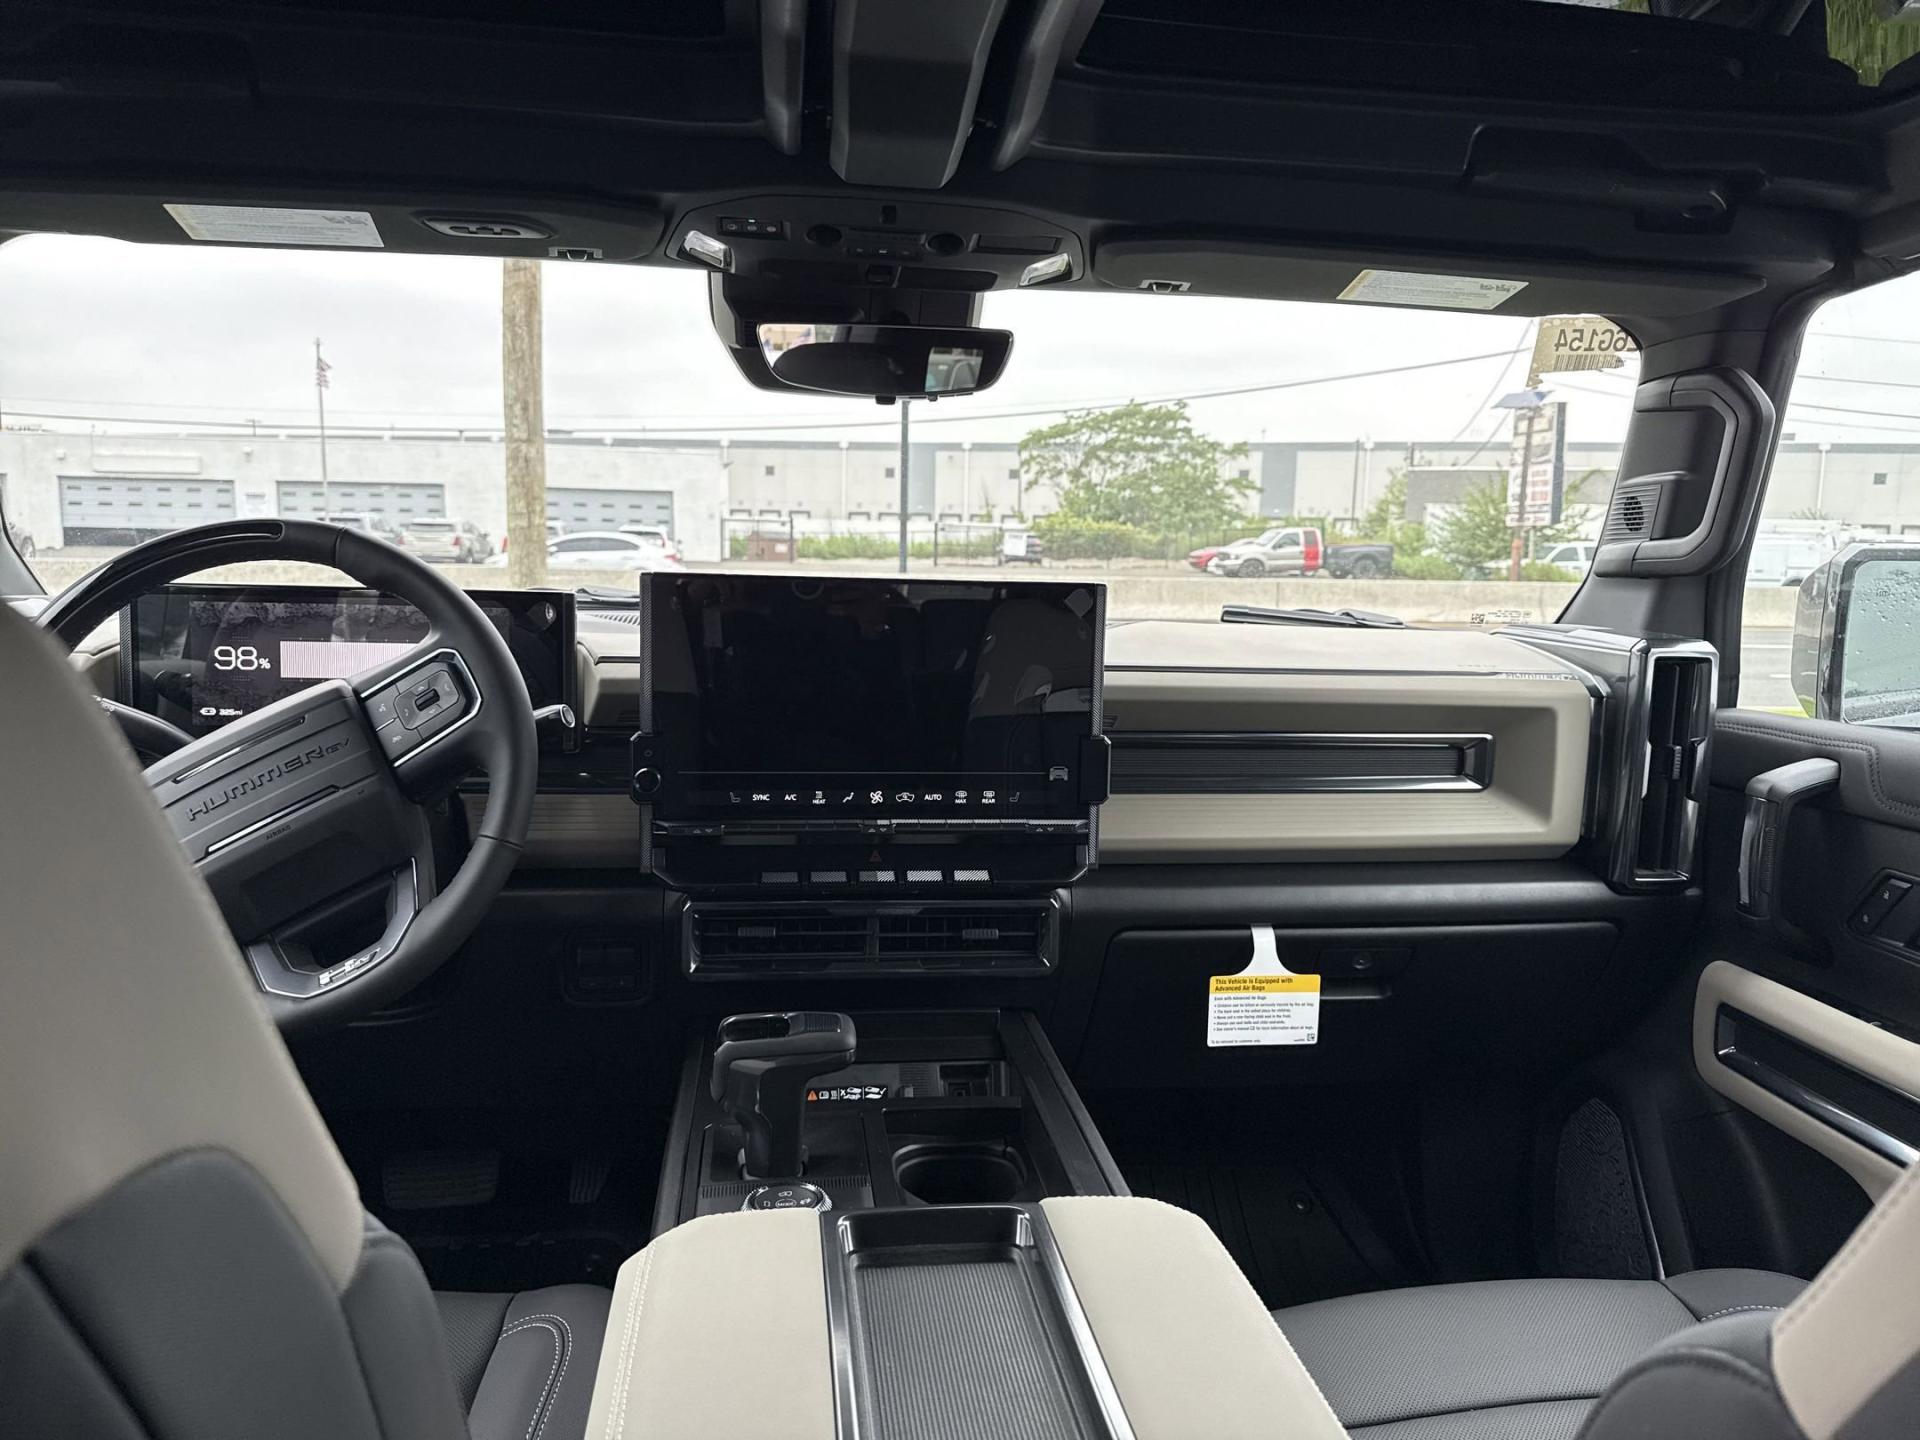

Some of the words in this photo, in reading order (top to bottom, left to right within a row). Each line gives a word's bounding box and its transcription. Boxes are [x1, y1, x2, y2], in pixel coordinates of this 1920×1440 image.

[214, 646, 271, 670] 98%
[189, 746, 325, 822] HUMMER
[1215, 984, 1241, 992] Advanced
[1251, 984, 1265, 992] Bags
